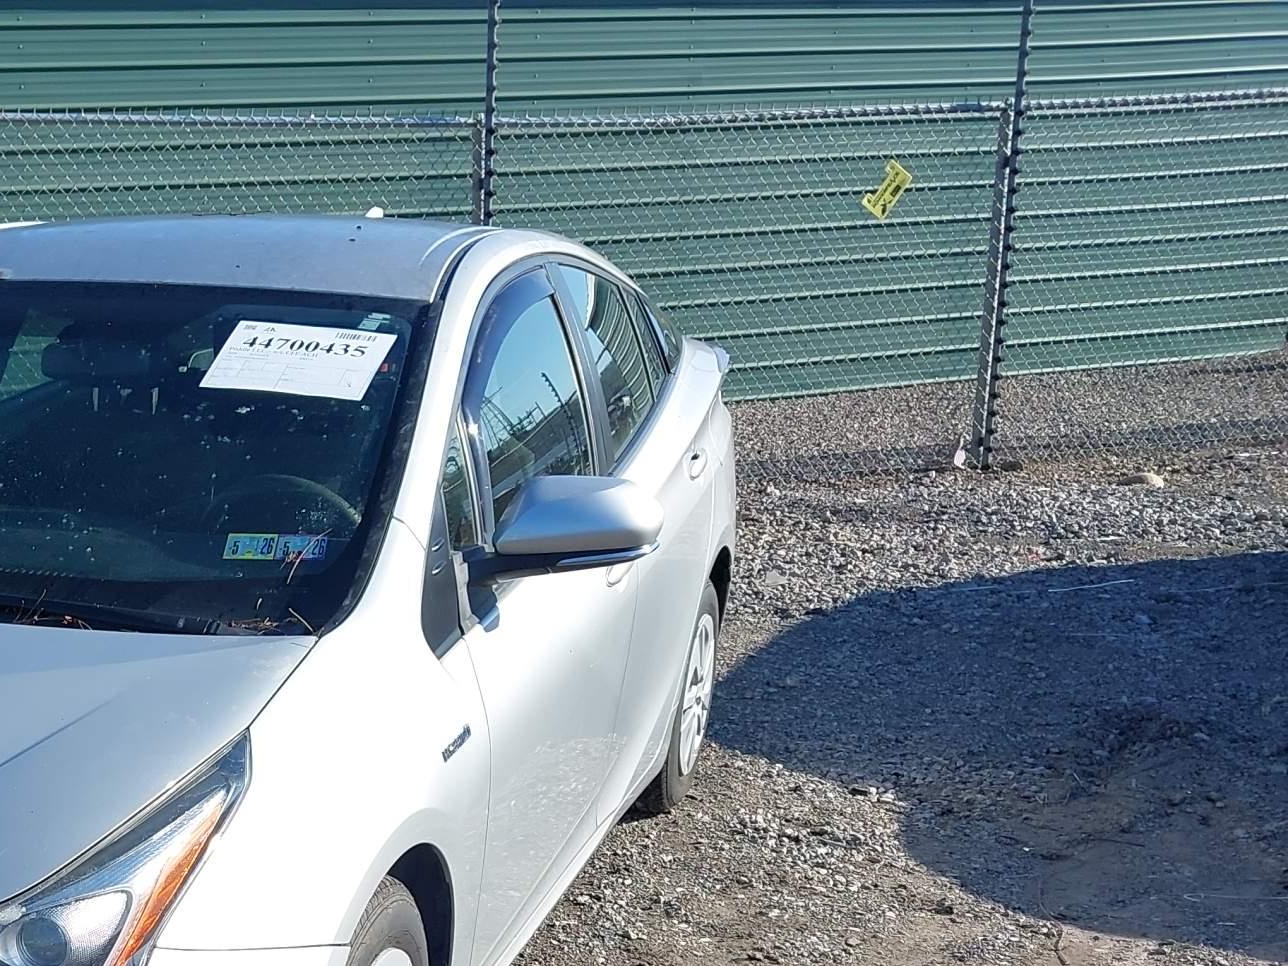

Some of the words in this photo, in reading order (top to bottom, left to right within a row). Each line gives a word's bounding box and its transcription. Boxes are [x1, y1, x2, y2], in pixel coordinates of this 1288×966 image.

[242, 335, 369, 358] 44700435
[231, 540, 240, 555] 5
[260, 538, 274, 555] 26
[282, 541, 290, 556] 5
[312, 539, 325, 556] 26
